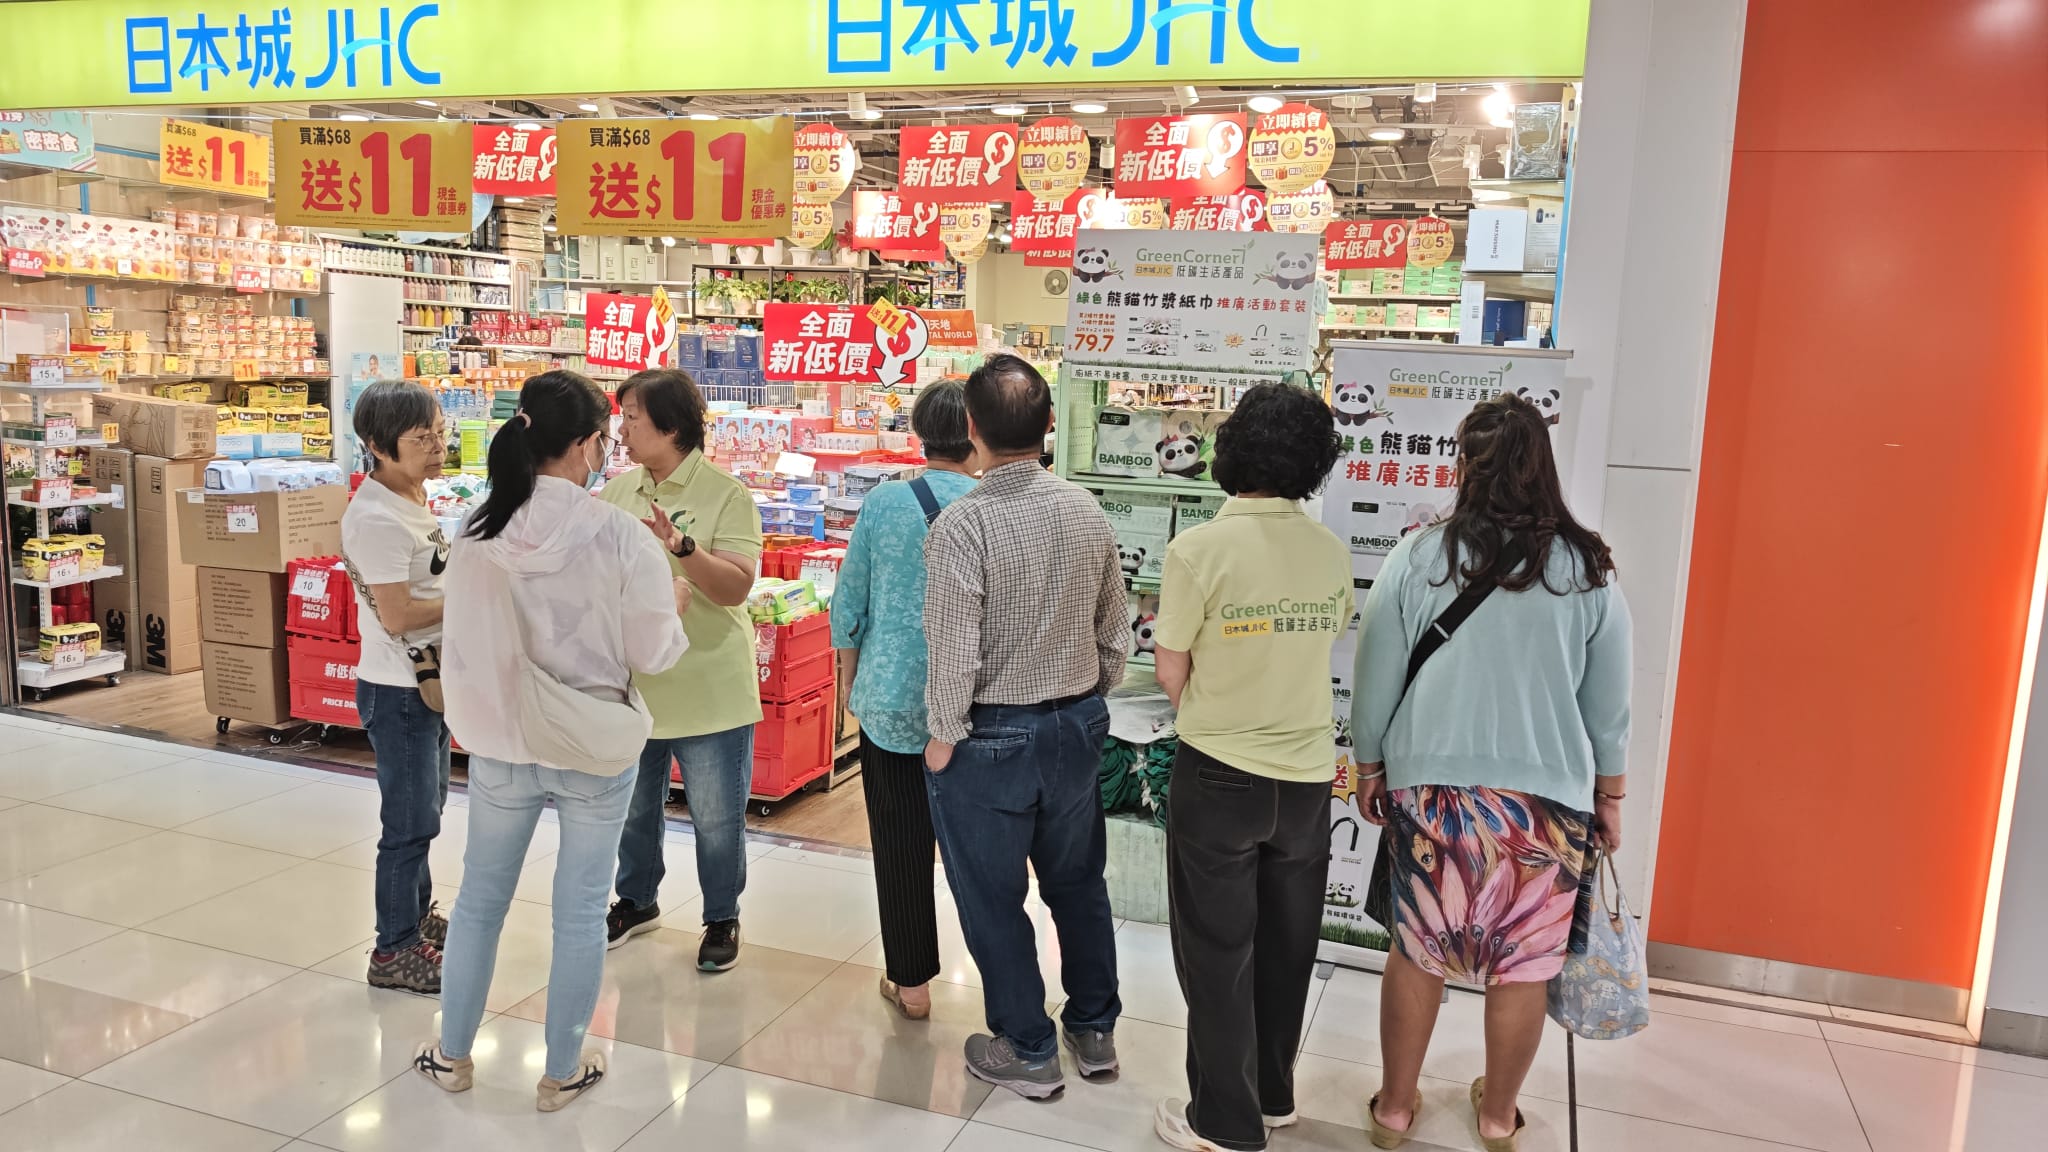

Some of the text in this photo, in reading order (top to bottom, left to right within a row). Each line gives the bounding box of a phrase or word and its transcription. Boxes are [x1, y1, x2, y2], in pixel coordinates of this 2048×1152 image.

[126, 4, 440, 93] 日本城 JHC
[1261, 112, 1321, 131] 立即續會
[24, 130, 78, 152] 密密食
[299, 127, 351, 146] 買滿$68
[494, 131, 529, 153] 全面
[589, 127, 651, 148] 買滿$68
[927, 130, 970, 155] 全面
[1026, 124, 1083, 142] 立即續會
[1144, 121, 1191, 146] 全面
[1253, 141, 1277, 156] 即享
[1304, 136, 1334, 157] 5%
[473, 154, 539, 183] 新低價
[903, 156, 984, 188] 新低價
[1118, 148, 1204, 183] 新低價
[437, 187, 457, 201] 現金
[751, 188, 775, 204] 現金
[437, 201, 467, 216] 優惠券
[751, 203, 786, 220] 優惠券
[1014, 214, 1077, 239] 新低價
[1344, 223, 1374, 239] 全面
[1136, 247, 1245, 265] GreenCorner
[1328, 241, 1383, 260] 新低價
[603, 301, 636, 328] 全面
[798, 311, 855, 338] 全面
[943, 331, 973, 339] WORLD
[587, 327, 645, 364] 新低價
[768, 340, 873, 376] 新低價
[1389, 368, 1503, 387] GreenCorner
[1099, 453, 1153, 466] BAMBOO
[1351, 536, 1398, 548] BAMBOO
[301, 610, 321, 619] DROP
[302, 603, 321, 612] PRICE
[1221, 597, 1336, 620] GreenCorner
[146, 613, 166, 668] 3M
[322, 697, 344, 707] PRICE
